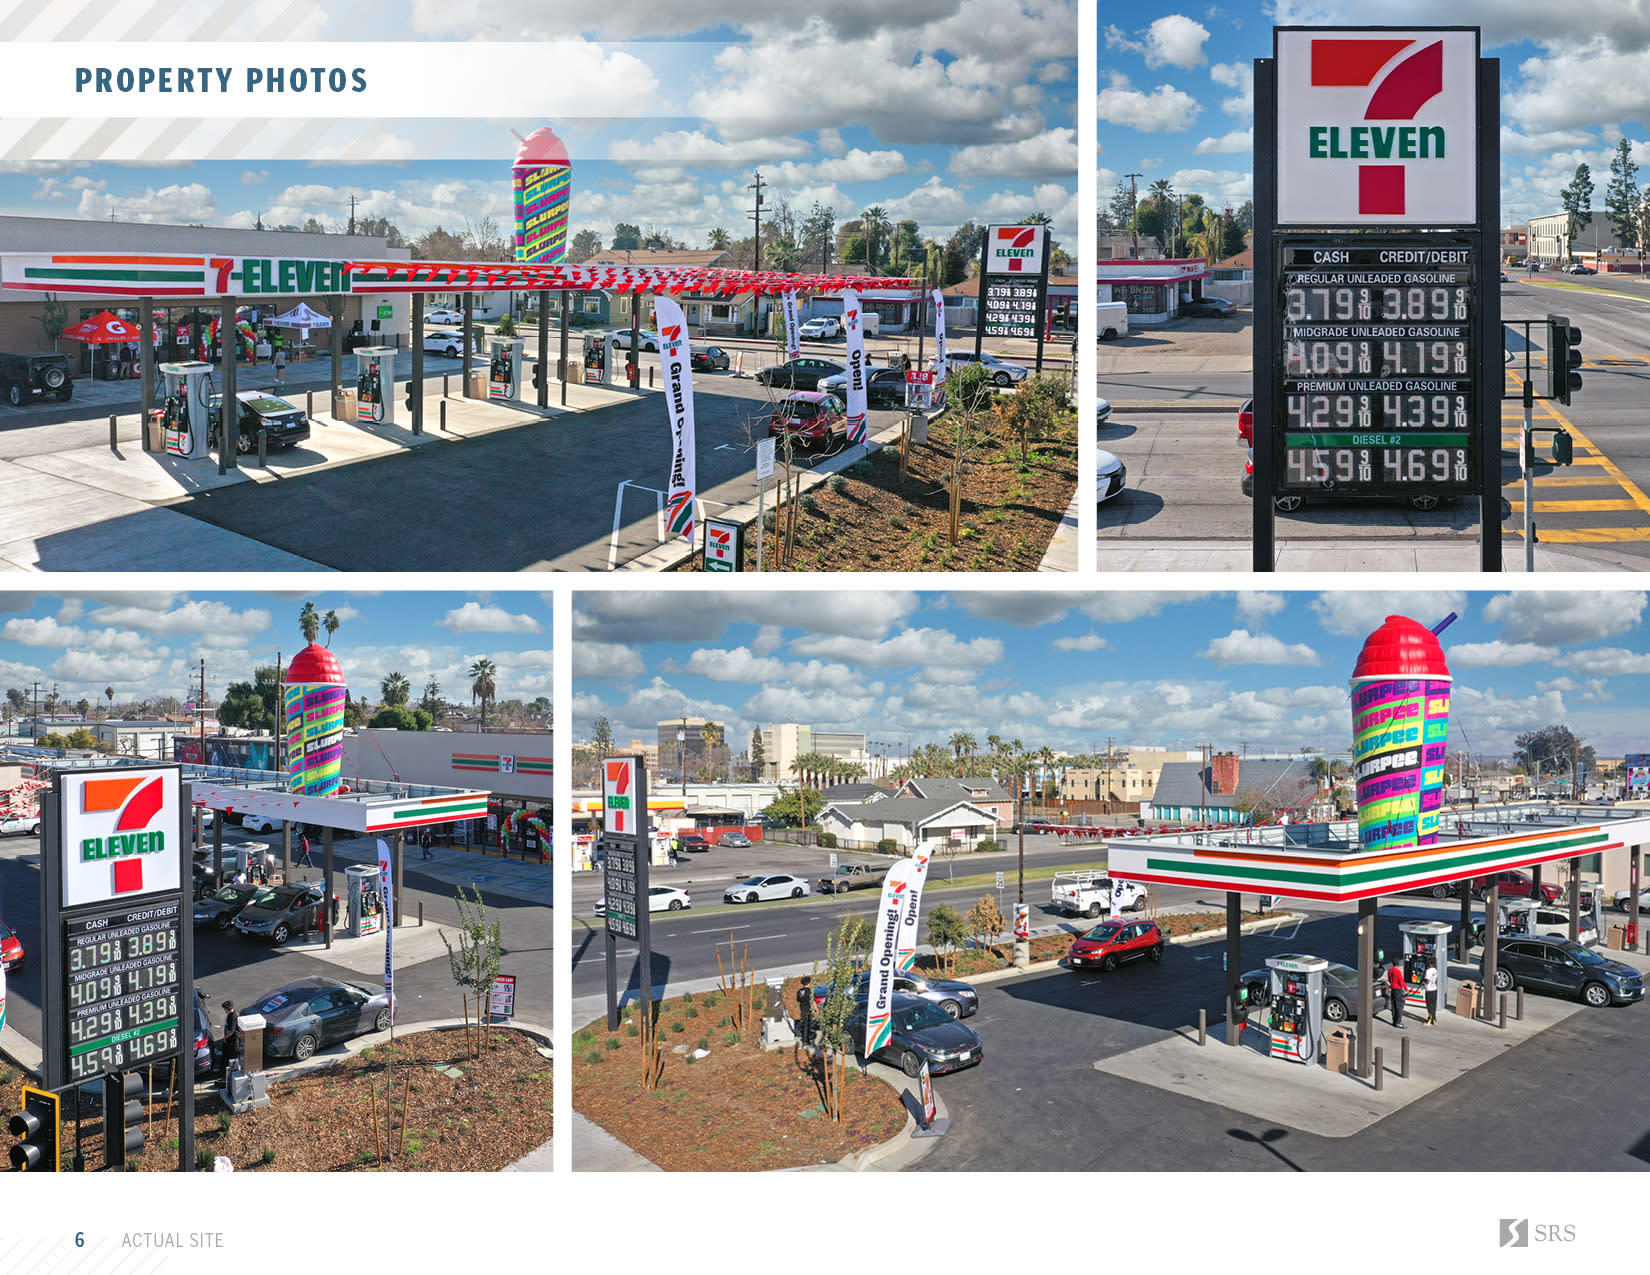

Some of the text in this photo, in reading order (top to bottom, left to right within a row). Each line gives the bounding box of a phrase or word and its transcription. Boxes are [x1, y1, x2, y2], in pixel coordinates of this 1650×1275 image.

[1313, 251, 1468, 264] CASH CREDIT/DEBIT
[1297, 274, 1456, 284] REGULAR UNLEADED GASOLINE
[1288, 289, 1353, 320] 3.79
[1383, 289, 1449, 320] 3.89
[1294, 327, 1460, 337] MIDGRADE UNLEADED GASOLINE
[850, 350, 863, 391] Open!
[1383, 342, 1449, 373] 4.19
[670, 362, 685, 414] Grand
[1297, 382, 1457, 391] PREMIUM UNLEADED GASOLINE
[1288, 396, 1353, 427] 4.29
[1383, 396, 1449, 427] 4.39
[1352, 435, 1400, 445] DIESEL #2
[1288, 450, 1353, 481] 4.59
[1383, 450, 1449, 481] 4.69
[86, 906, 178, 930] CASH CREDIT/DEBIT
[905, 889, 918, 926] Open!
[77, 921, 171, 946] REGULAR UNLEADED GASOLINE
[128, 932, 166, 957] 3.89
[71, 942, 111, 971] 3.79
[74, 954, 172, 982] MIDGRADE UNLEADED GASOLINE
[876, 909, 899, 1009] Grand Opening!
[71, 977, 111, 1005] 4.09
[128, 965, 166, 991] 4.19
[77, 988, 171, 1017] PREMIUM UNLEADED GASOLINE
[129, 998, 167, 1024] 4.39
[71, 1012, 111, 1041] 4.29
[111, 1032, 132, 1043] DIESEL
[130, 1031, 167, 1059] 4.69
